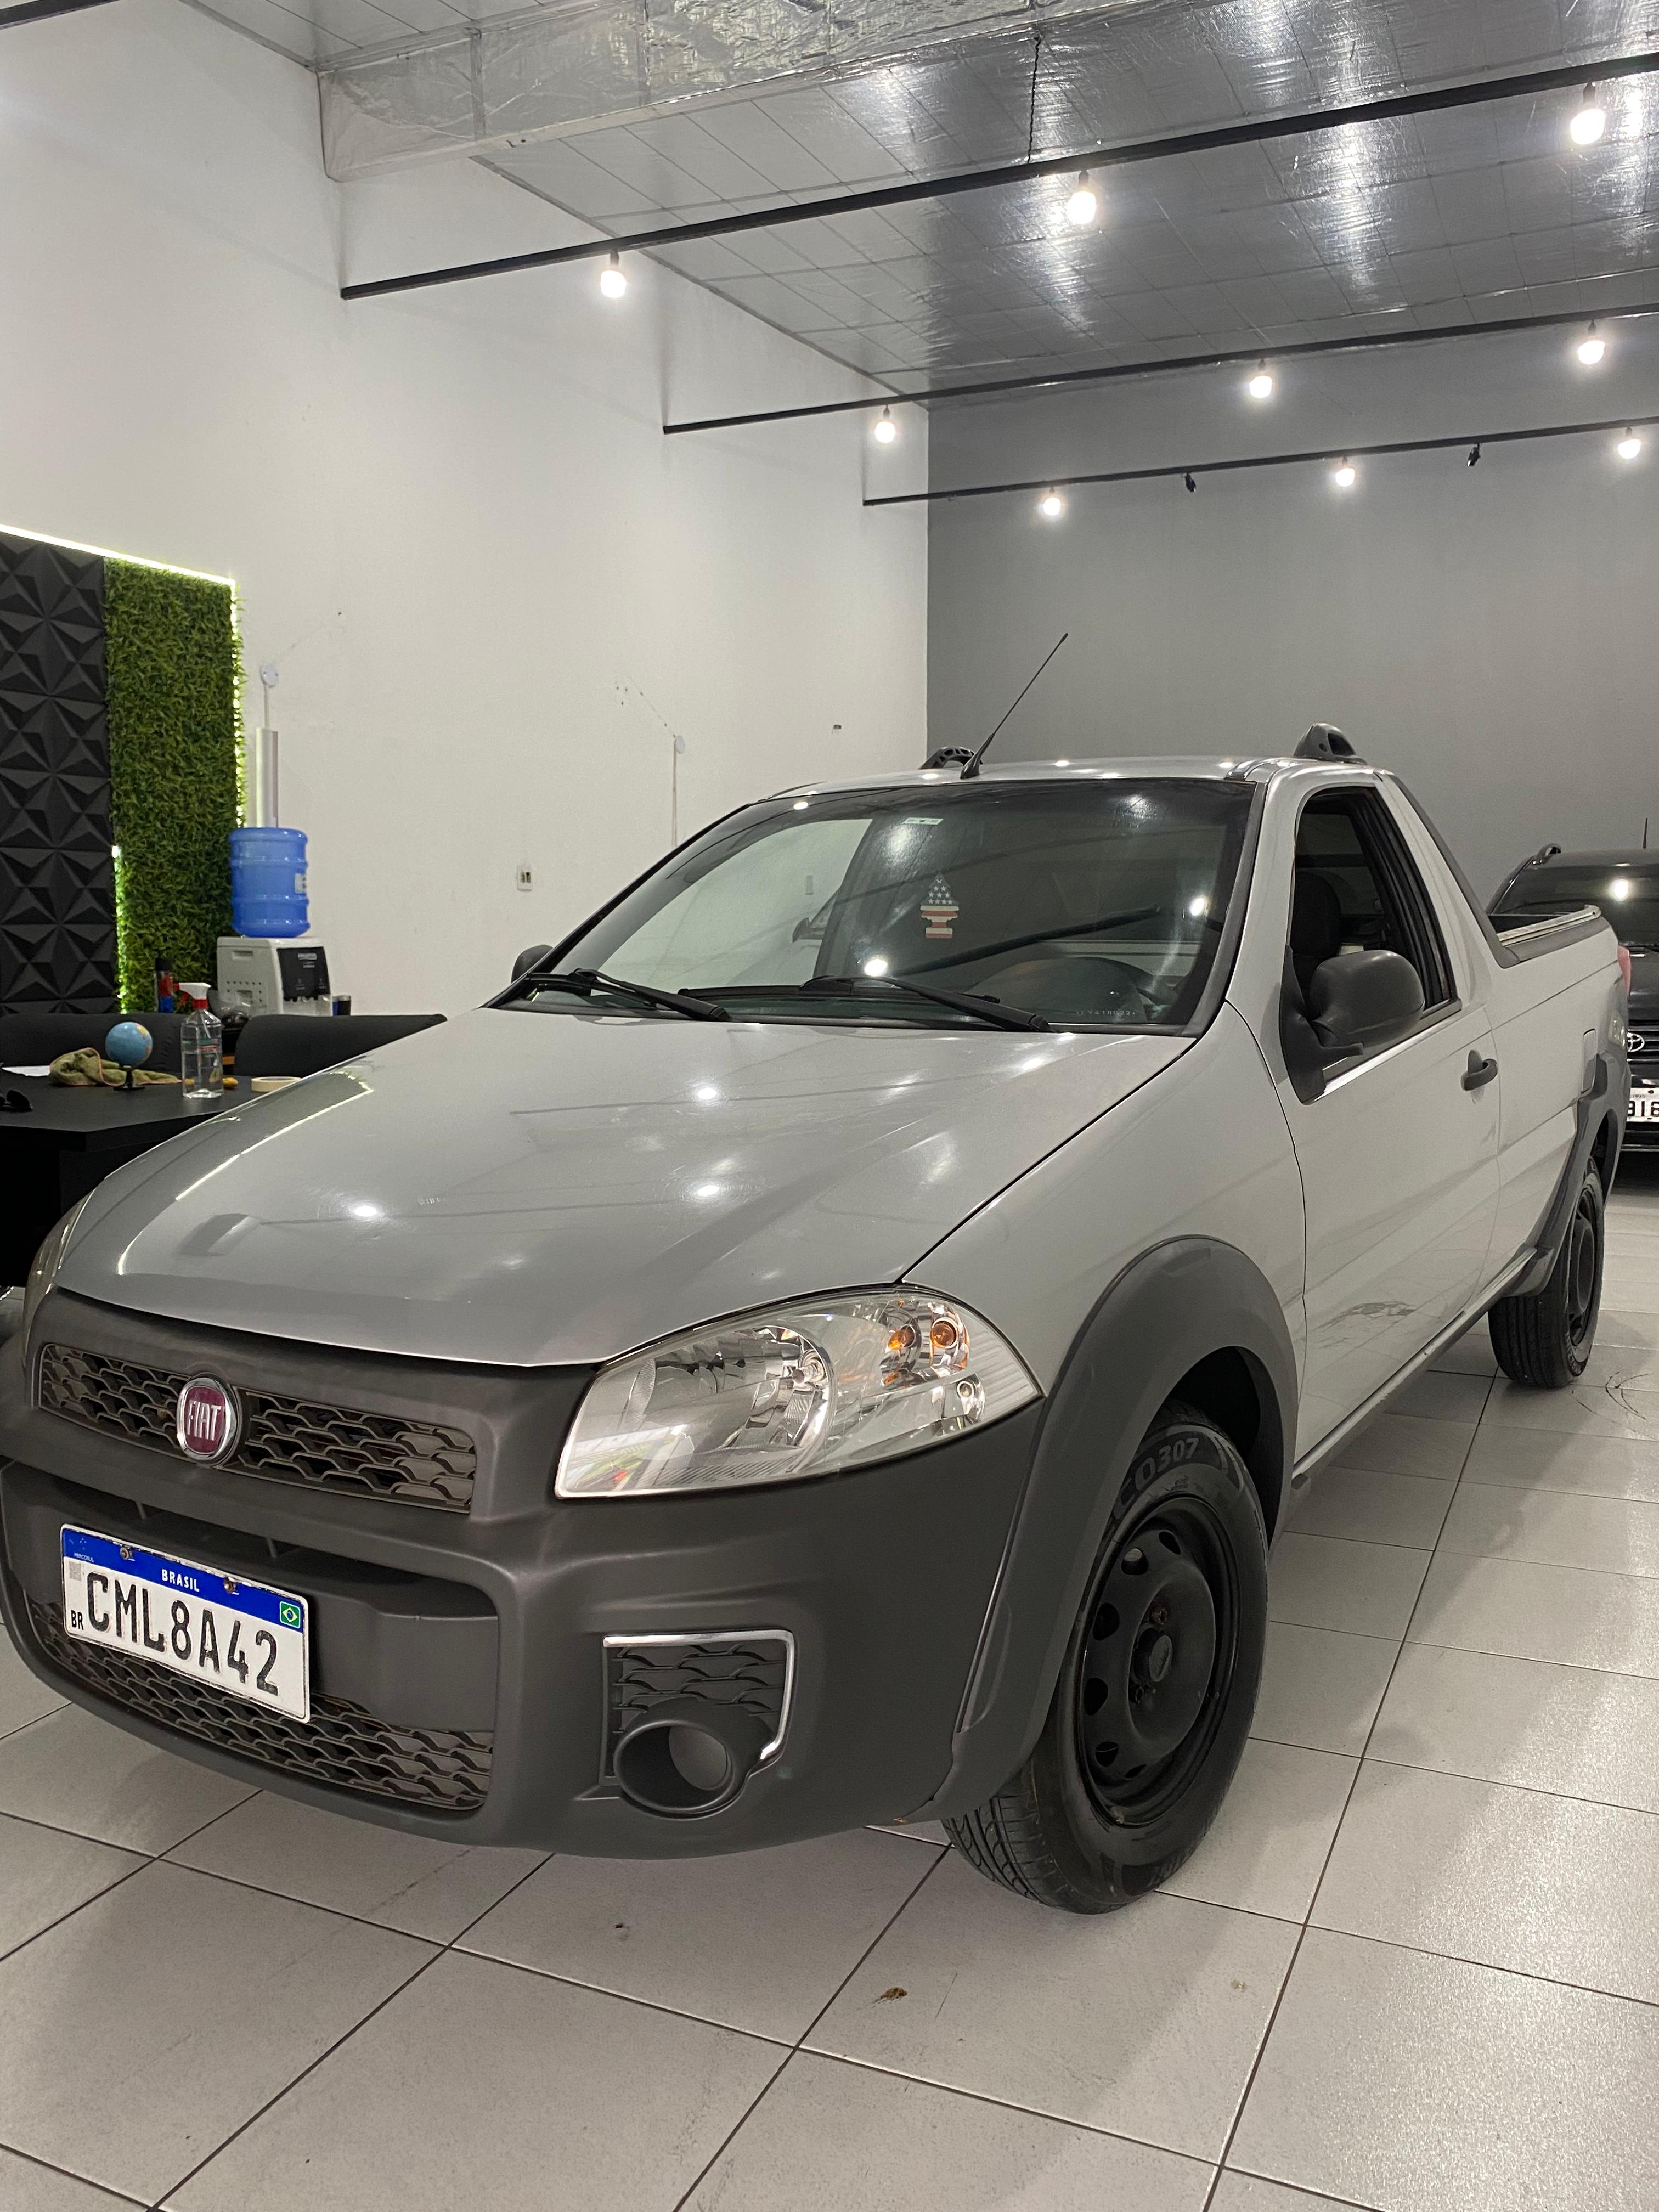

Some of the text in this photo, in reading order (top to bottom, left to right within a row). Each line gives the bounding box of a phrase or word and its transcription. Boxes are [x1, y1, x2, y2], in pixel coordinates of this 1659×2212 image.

[187, 1399, 222, 1441] FIAT
[161, 1568, 200, 1592] BRASIL
[71, 1610, 84, 1630] BR
[87, 1572, 279, 1696] CML8A42
